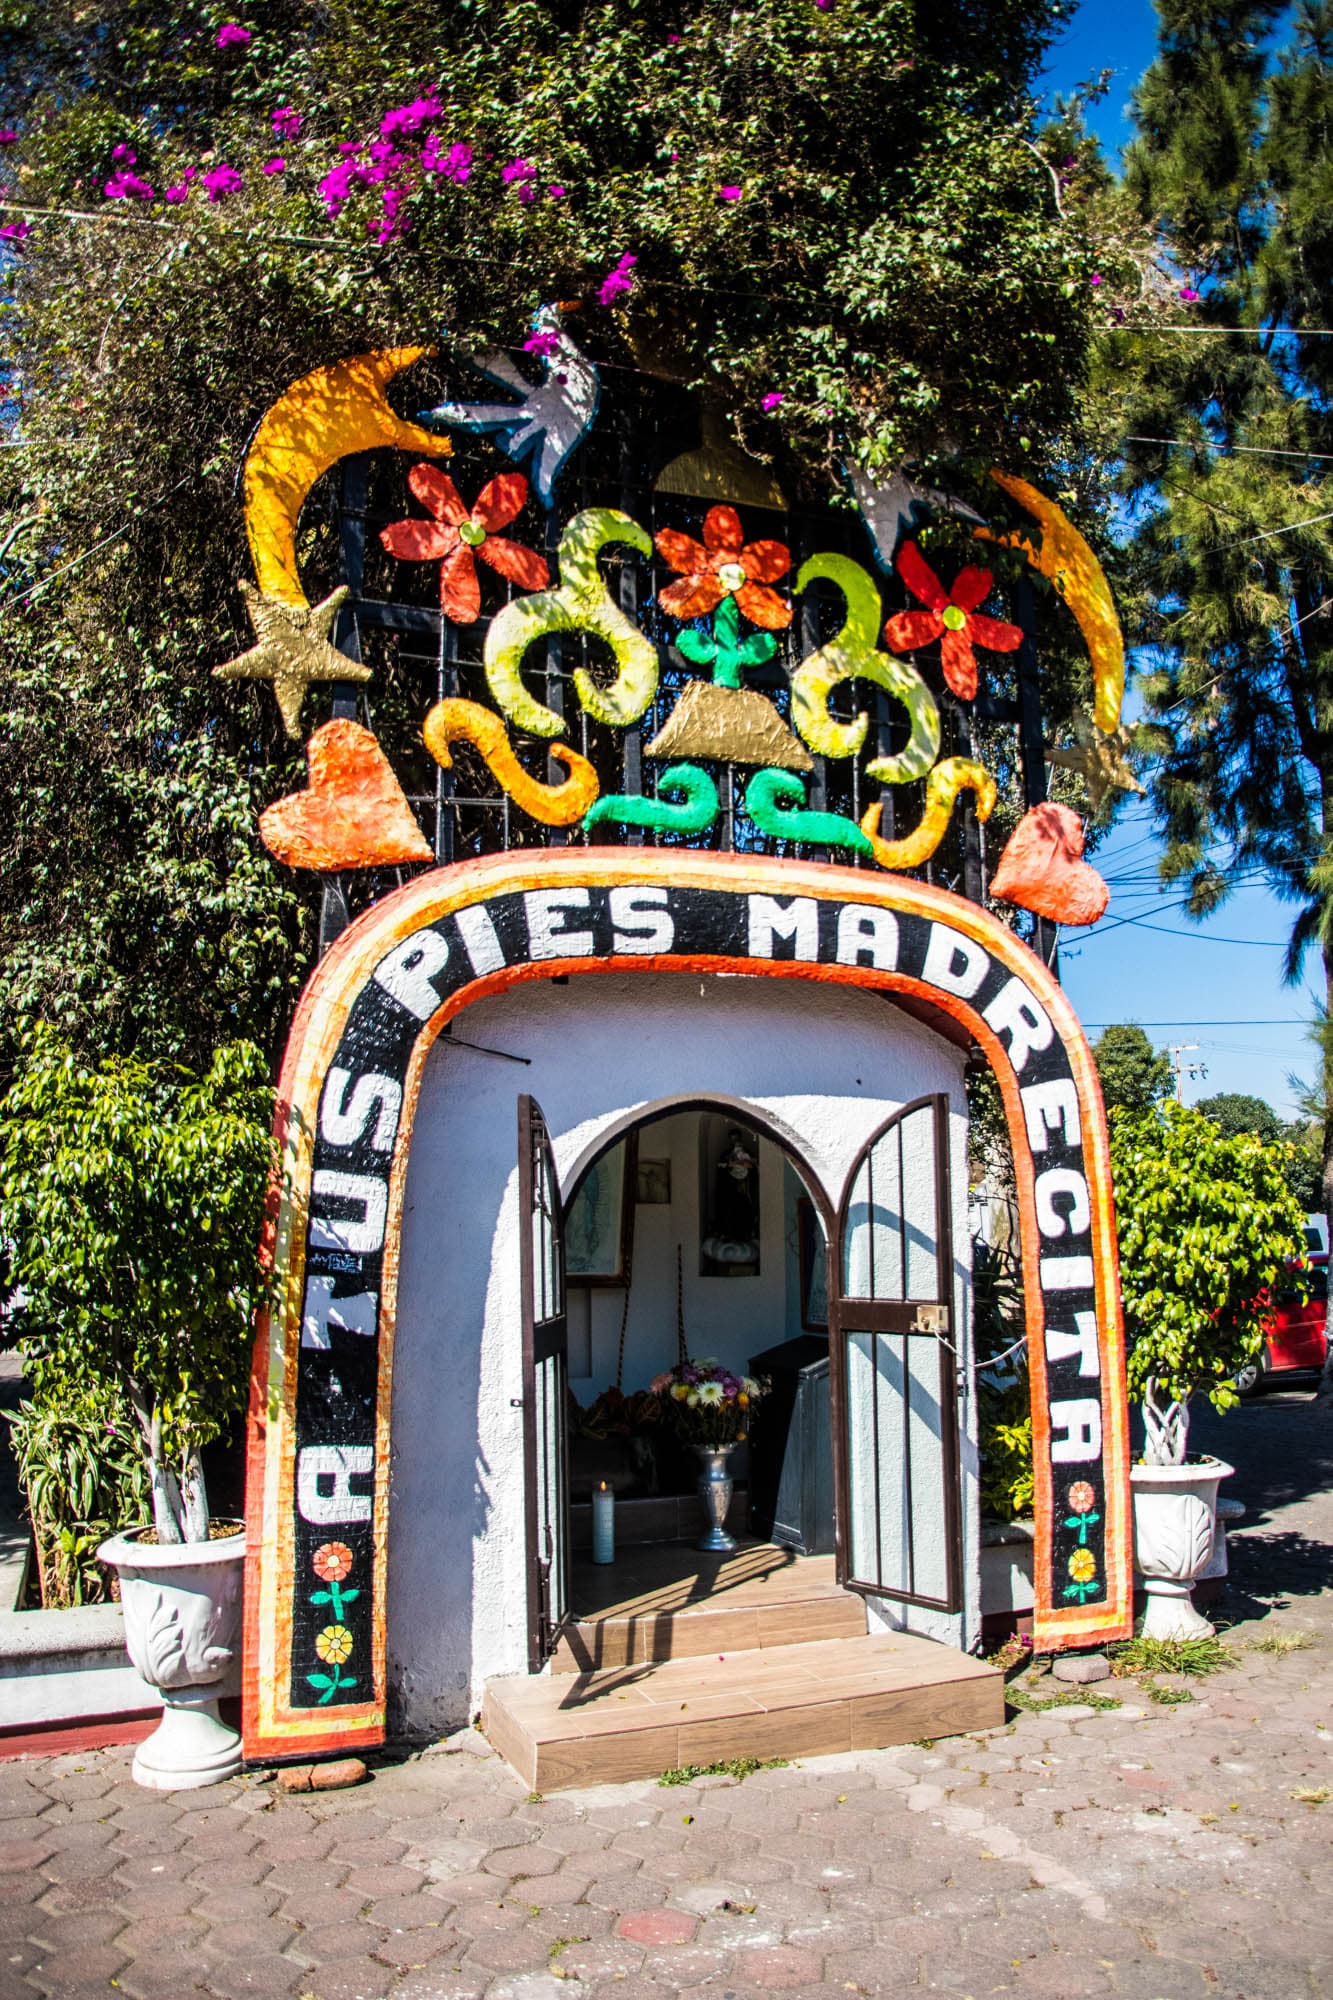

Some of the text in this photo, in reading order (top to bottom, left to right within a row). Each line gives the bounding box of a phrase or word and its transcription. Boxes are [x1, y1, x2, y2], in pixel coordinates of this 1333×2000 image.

[298, 887, 1102, 1525] A TUS PIES MADRECITA
